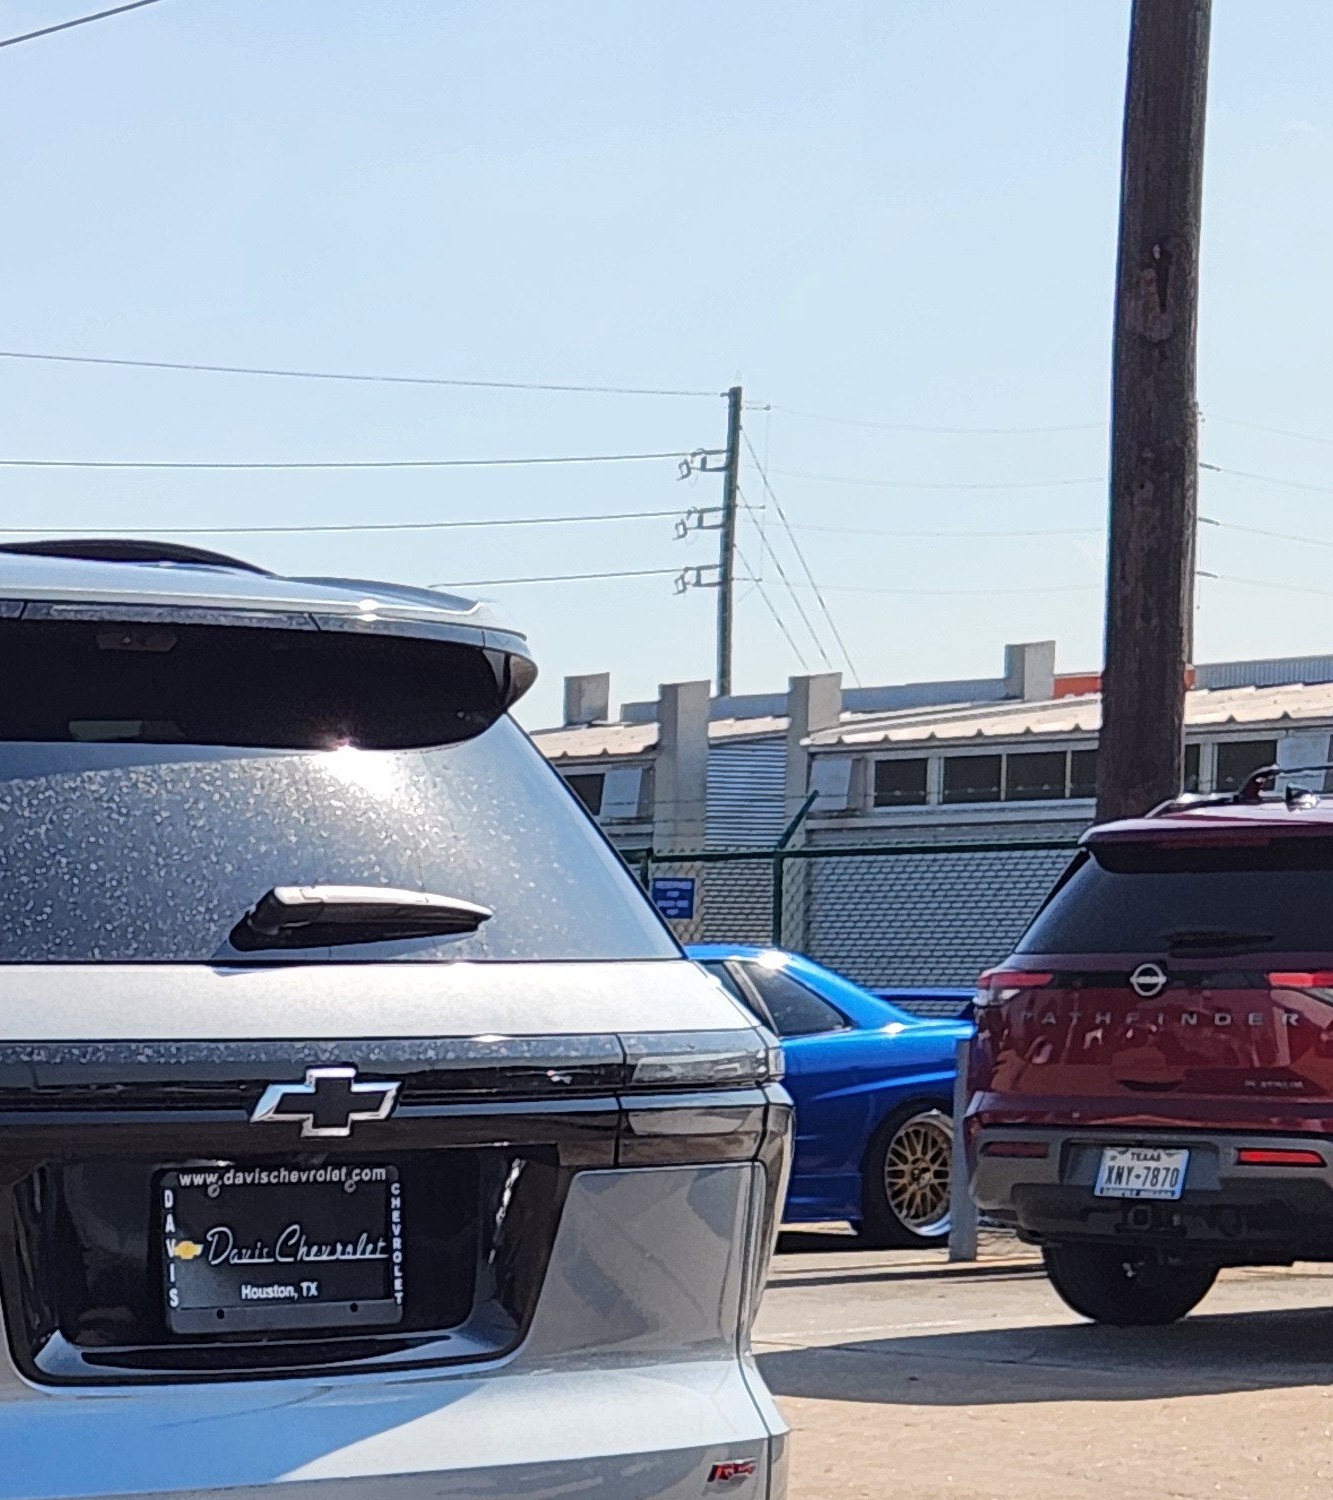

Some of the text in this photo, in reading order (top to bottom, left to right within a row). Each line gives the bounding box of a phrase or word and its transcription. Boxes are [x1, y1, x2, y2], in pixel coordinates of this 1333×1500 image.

[1022, 1012, 1300, 1026] PATHFINDER
[178, 1165, 387, 1188] www.davischevroletcom
[163, 1189, 180, 1308] DAVIS
[206, 1223, 390, 1266] Davis Chevrolet
[390, 1182, 404, 1305] CHEVROLET
[241, 1281, 319, 1301] Houston, TX
